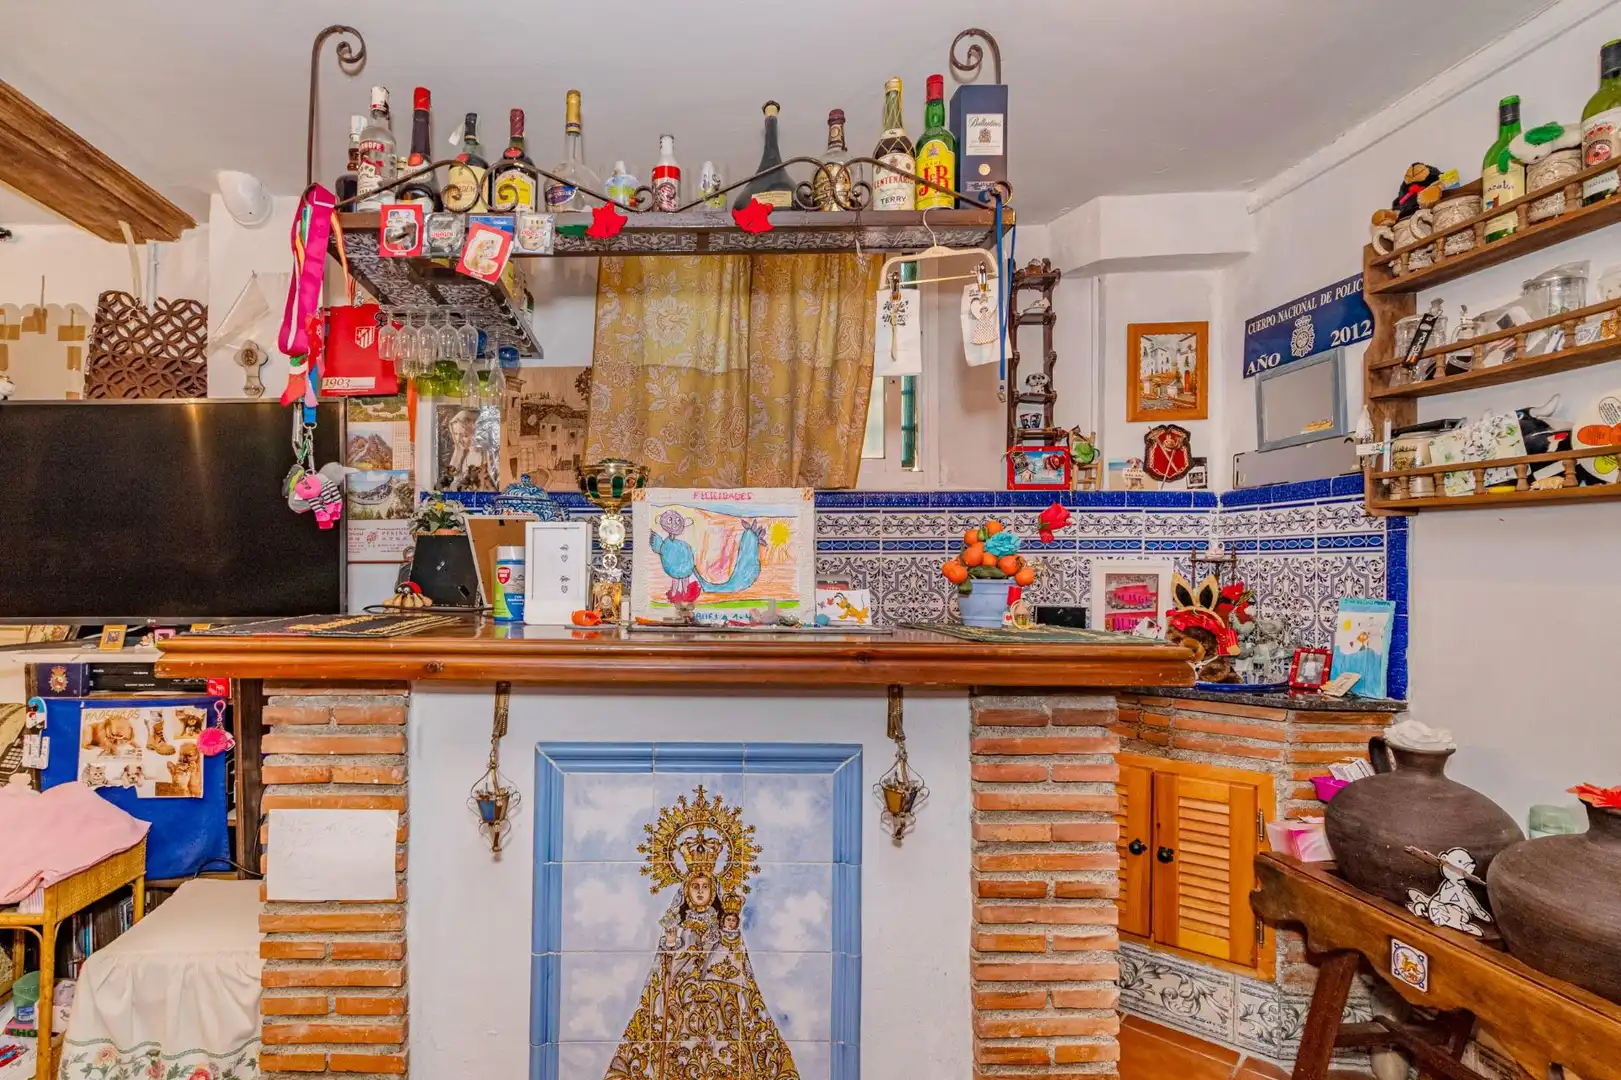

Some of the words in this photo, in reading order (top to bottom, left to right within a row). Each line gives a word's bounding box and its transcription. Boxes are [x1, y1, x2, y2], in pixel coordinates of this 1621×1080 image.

[880, 195, 907, 205] TERRY
[1248, 317, 1276, 334] CUERPO
[1278, 299, 1318, 322] NACIONAL
[1320, 291, 1332, 306] DE
[1246, 352, 1281, 375] AÑO
[1330, 320, 1372, 347] 2012
[324, 379, 351, 388] 1903
